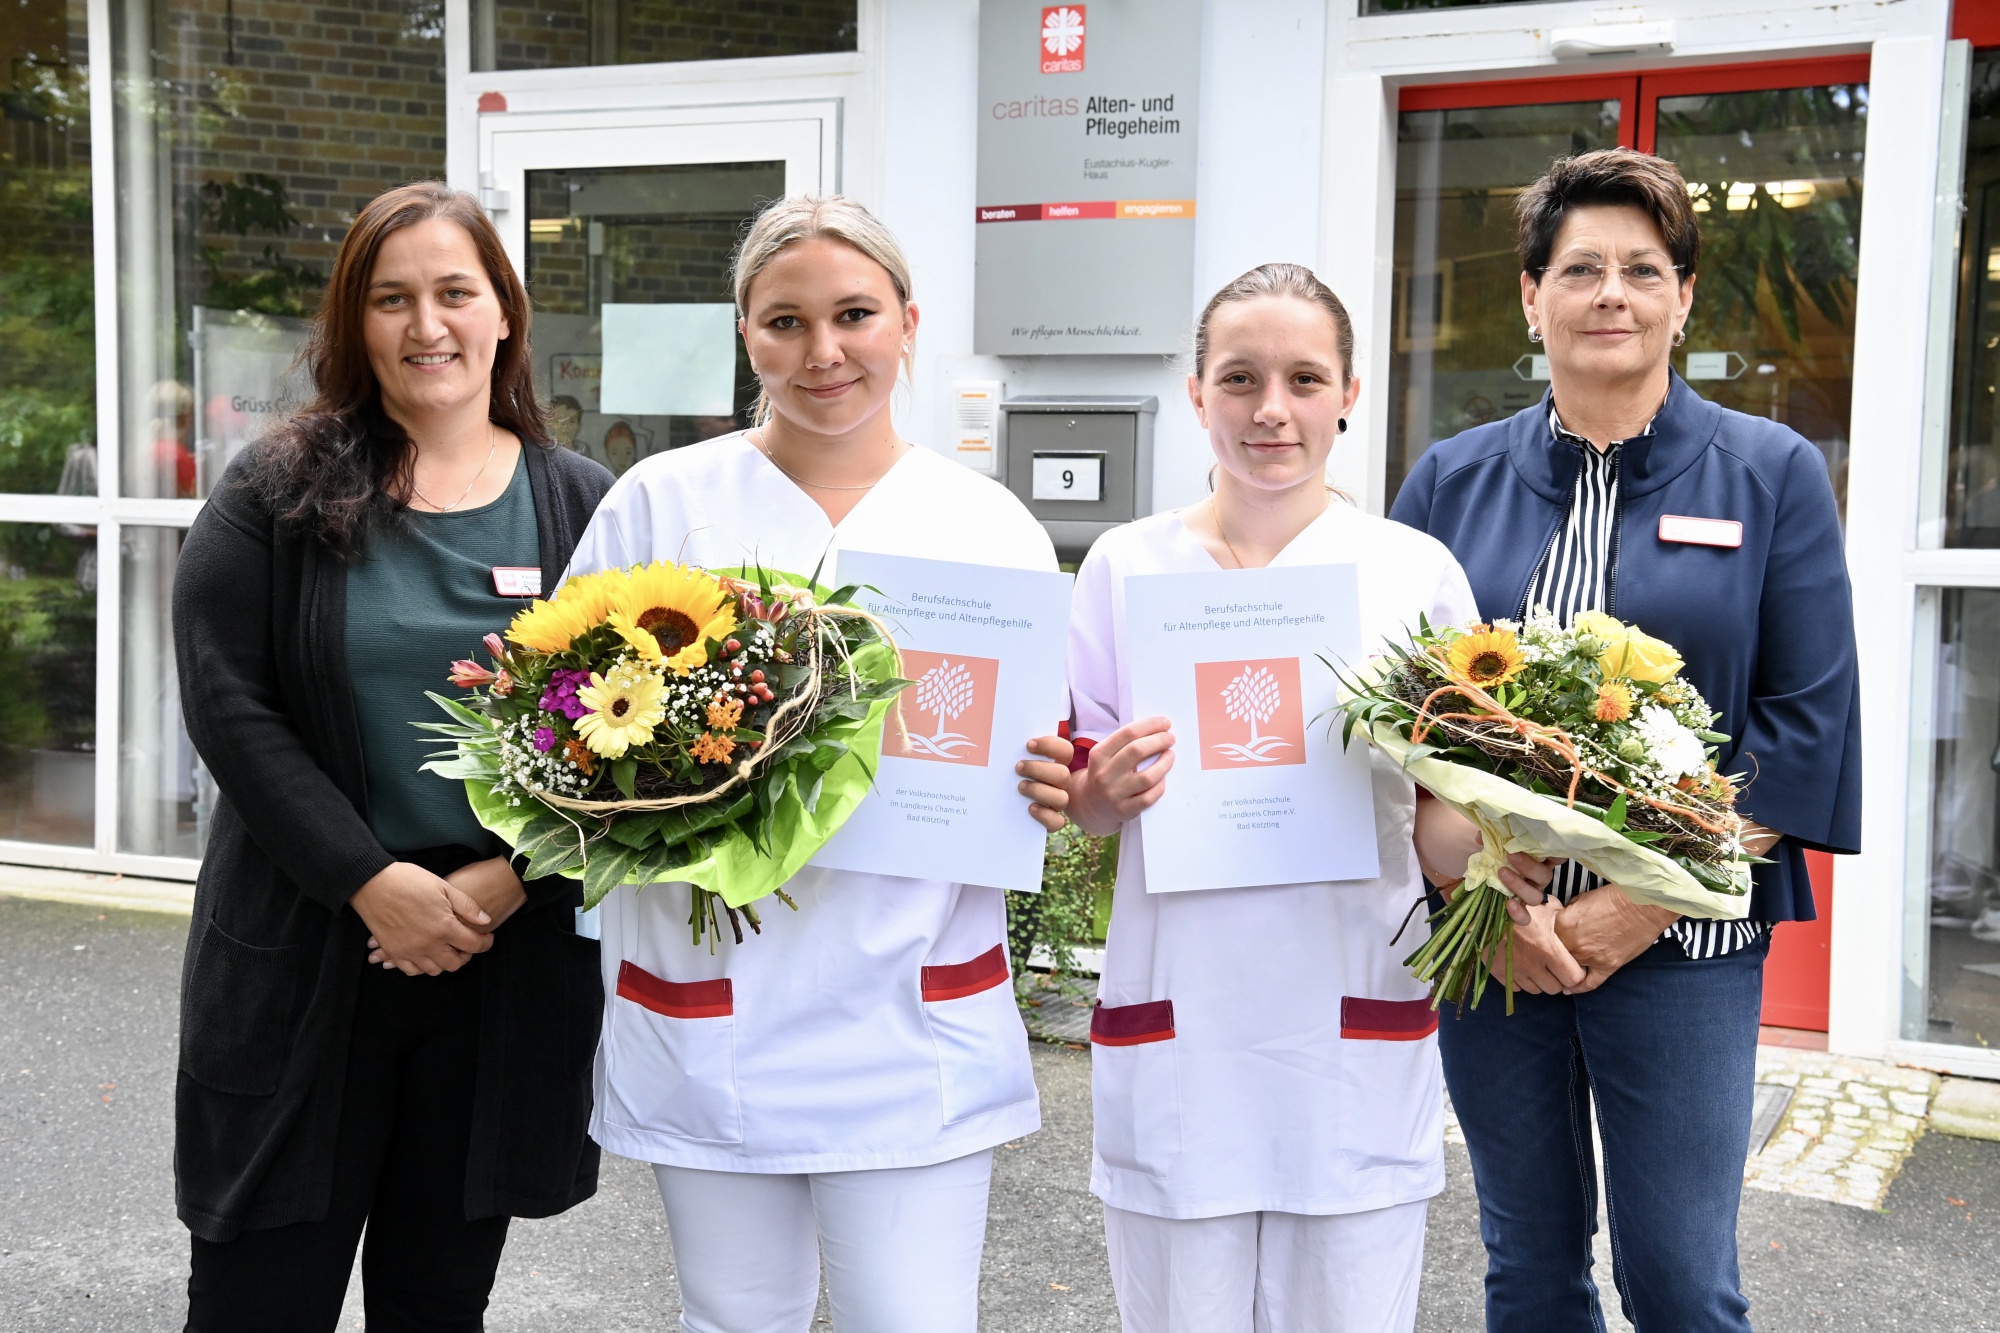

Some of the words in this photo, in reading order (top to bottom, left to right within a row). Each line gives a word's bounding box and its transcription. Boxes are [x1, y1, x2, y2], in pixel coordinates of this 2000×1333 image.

[1042, 57, 1082, 73] caritas
[992, 95, 1079, 120] caritas
[1086, 96, 1136, 114] Alten-
[1142, 94, 1174, 112] und
[1086, 116, 1180, 139] Pflegeheim
[1084, 170, 1108, 180] Haus
[981, 208, 1016, 220] beraten
[1049, 205, 1079, 217] helfen
[1124, 204, 1183, 216] engagieren
[1011, 327, 1029, 336] Wir
[1029, 325, 1063, 340] pflegen
[1062, 469, 1074, 489] 9
[911, 592, 992, 609] Berufsfachschule
[1204, 601, 1283, 615] Berufsfachschule
[867, 602, 880, 612] für
[883, 604, 936, 620] Altenpflege
[938, 612, 957, 621] und
[959, 613, 1033, 629] Altenpflegehilfe
[1163, 622, 1177, 632] für
[1179, 619, 1231, 631] Altenpflege
[1233, 618, 1251, 628] und
[1253, 614, 1325, 627] Altenpflegehilfe
[895, 788, 908, 796] der
[909, 789, 966, 802] Volkshochschule
[1221, 799, 1233, 807] der
[1234, 795, 1291, 806] Volkshochschule
[900, 801, 934, 811] Landkreis
[935, 805, 954, 814] Cham
[1229, 810, 1262, 819] Landkreis
[1263, 809, 1282, 817] Cham
[1283, 808, 1296, 816] e.V.
[906, 814, 920, 822] Bad
[921, 815, 950, 826] Kötzting
[1237, 822, 1250, 830] Bad
[1251, 820, 1280, 829] Kötzting
